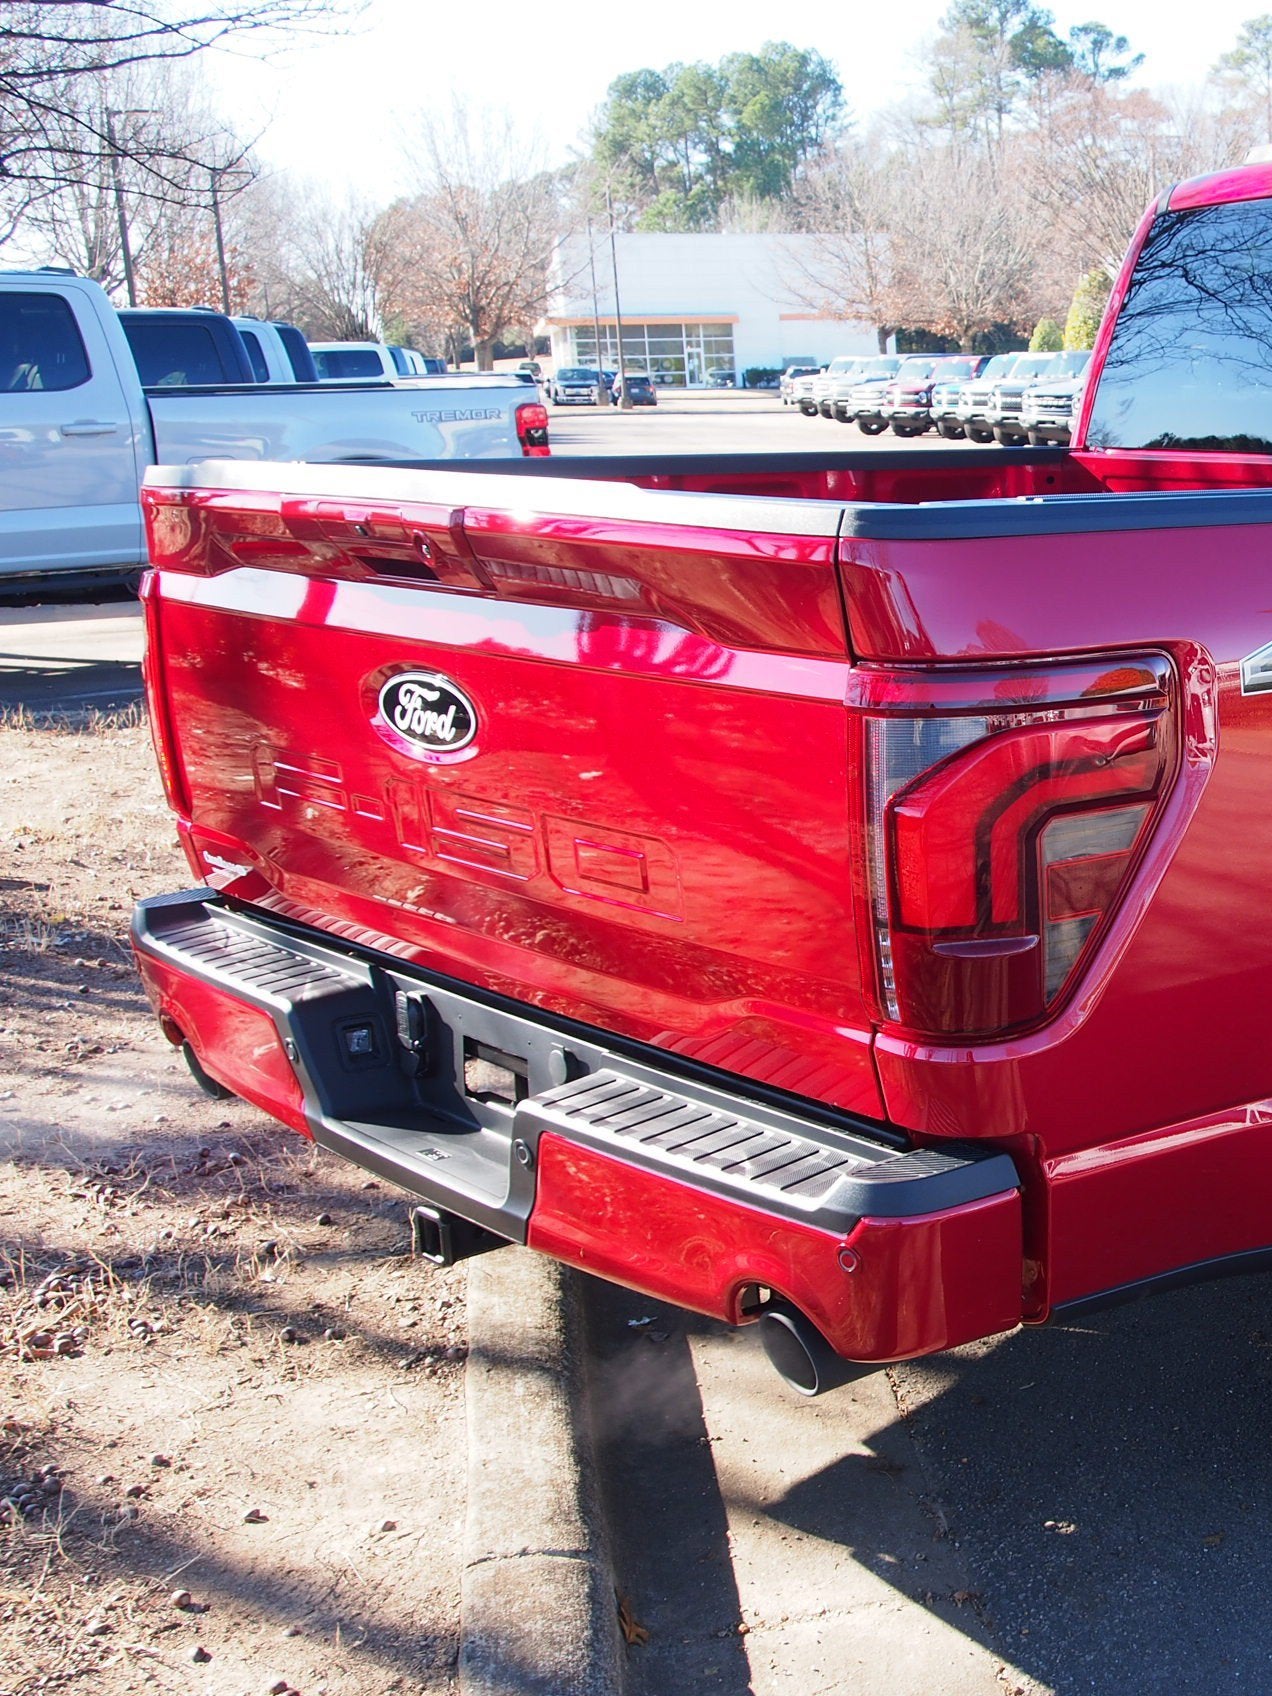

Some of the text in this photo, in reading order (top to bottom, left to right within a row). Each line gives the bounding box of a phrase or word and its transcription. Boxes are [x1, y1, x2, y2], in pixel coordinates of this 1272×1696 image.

[411, 408, 502, 423] TREMOR
[394, 683, 457, 741] Ford
[251, 742, 686, 924] F-150
